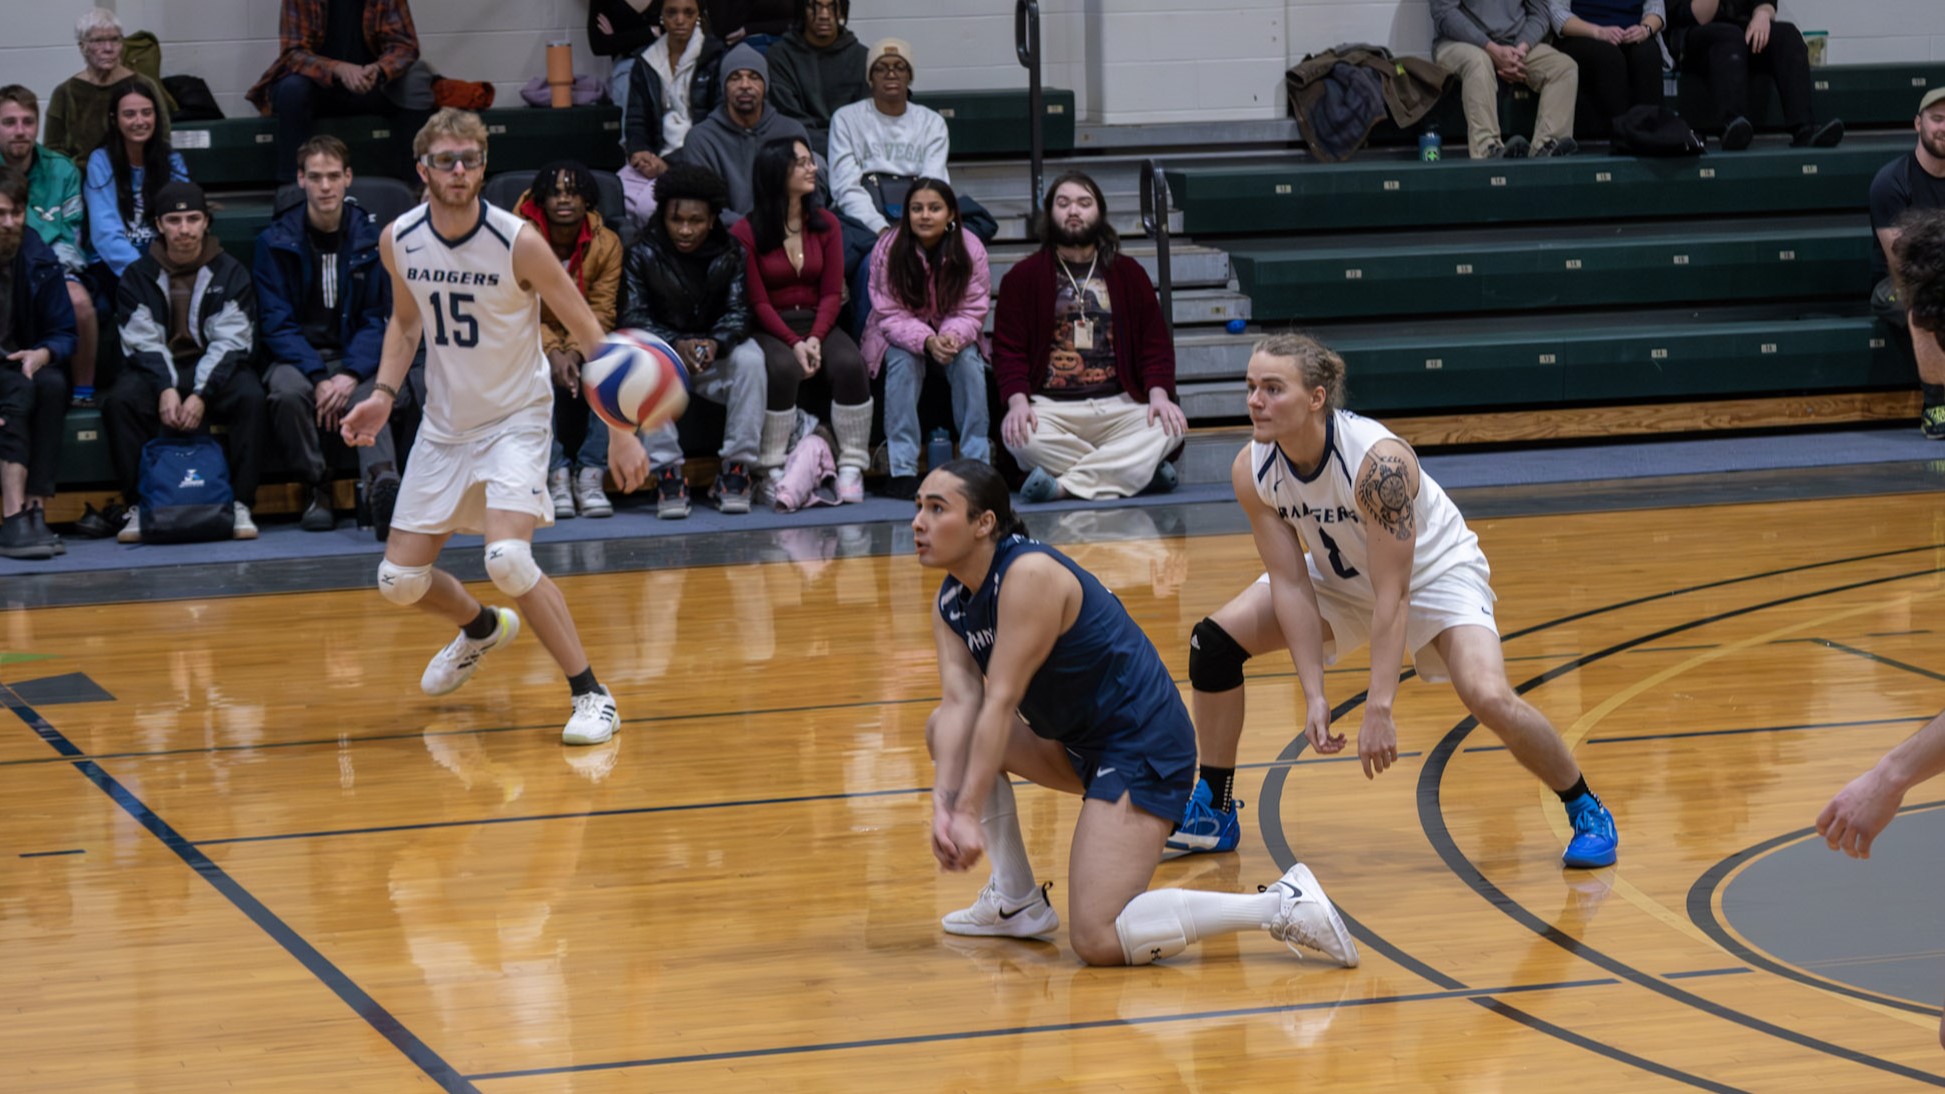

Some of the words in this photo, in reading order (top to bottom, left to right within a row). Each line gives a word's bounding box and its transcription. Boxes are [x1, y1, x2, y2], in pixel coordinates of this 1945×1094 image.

[860, 139, 881, 161] AS
[883, 141, 925, 164] VEGA
[406, 267, 499, 286] BADGERS
[429, 291, 479, 348] 15
